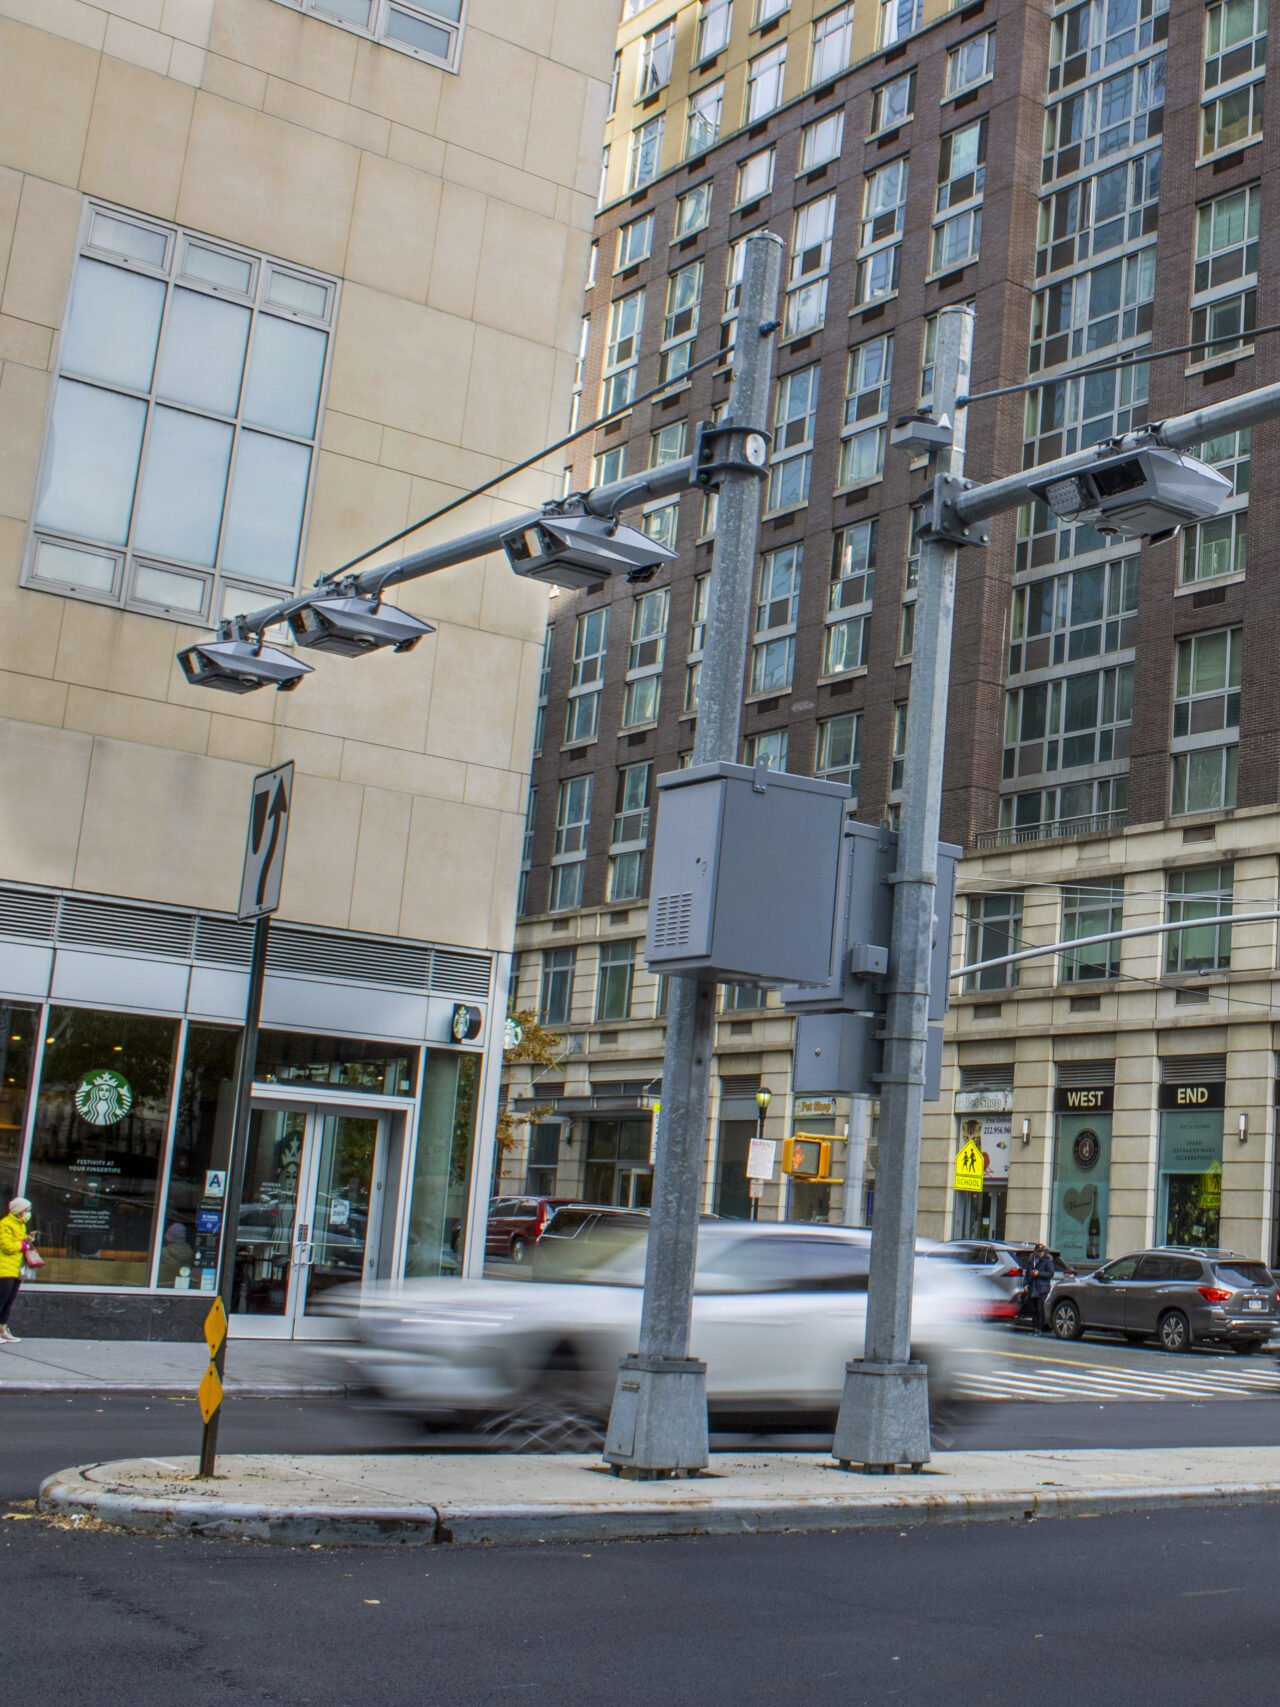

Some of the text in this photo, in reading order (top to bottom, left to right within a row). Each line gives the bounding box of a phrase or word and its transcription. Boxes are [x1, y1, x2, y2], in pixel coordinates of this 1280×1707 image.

[981, 1096, 1001, 1110] Shop
[1067, 1090, 1104, 1107] WEST
[1177, 1088, 1209, 1104] END
[801, 1101, 832, 1112] Pet Shop
[208, 1173, 222, 1188] A
[956, 1177, 980, 1188] SCHOOL
